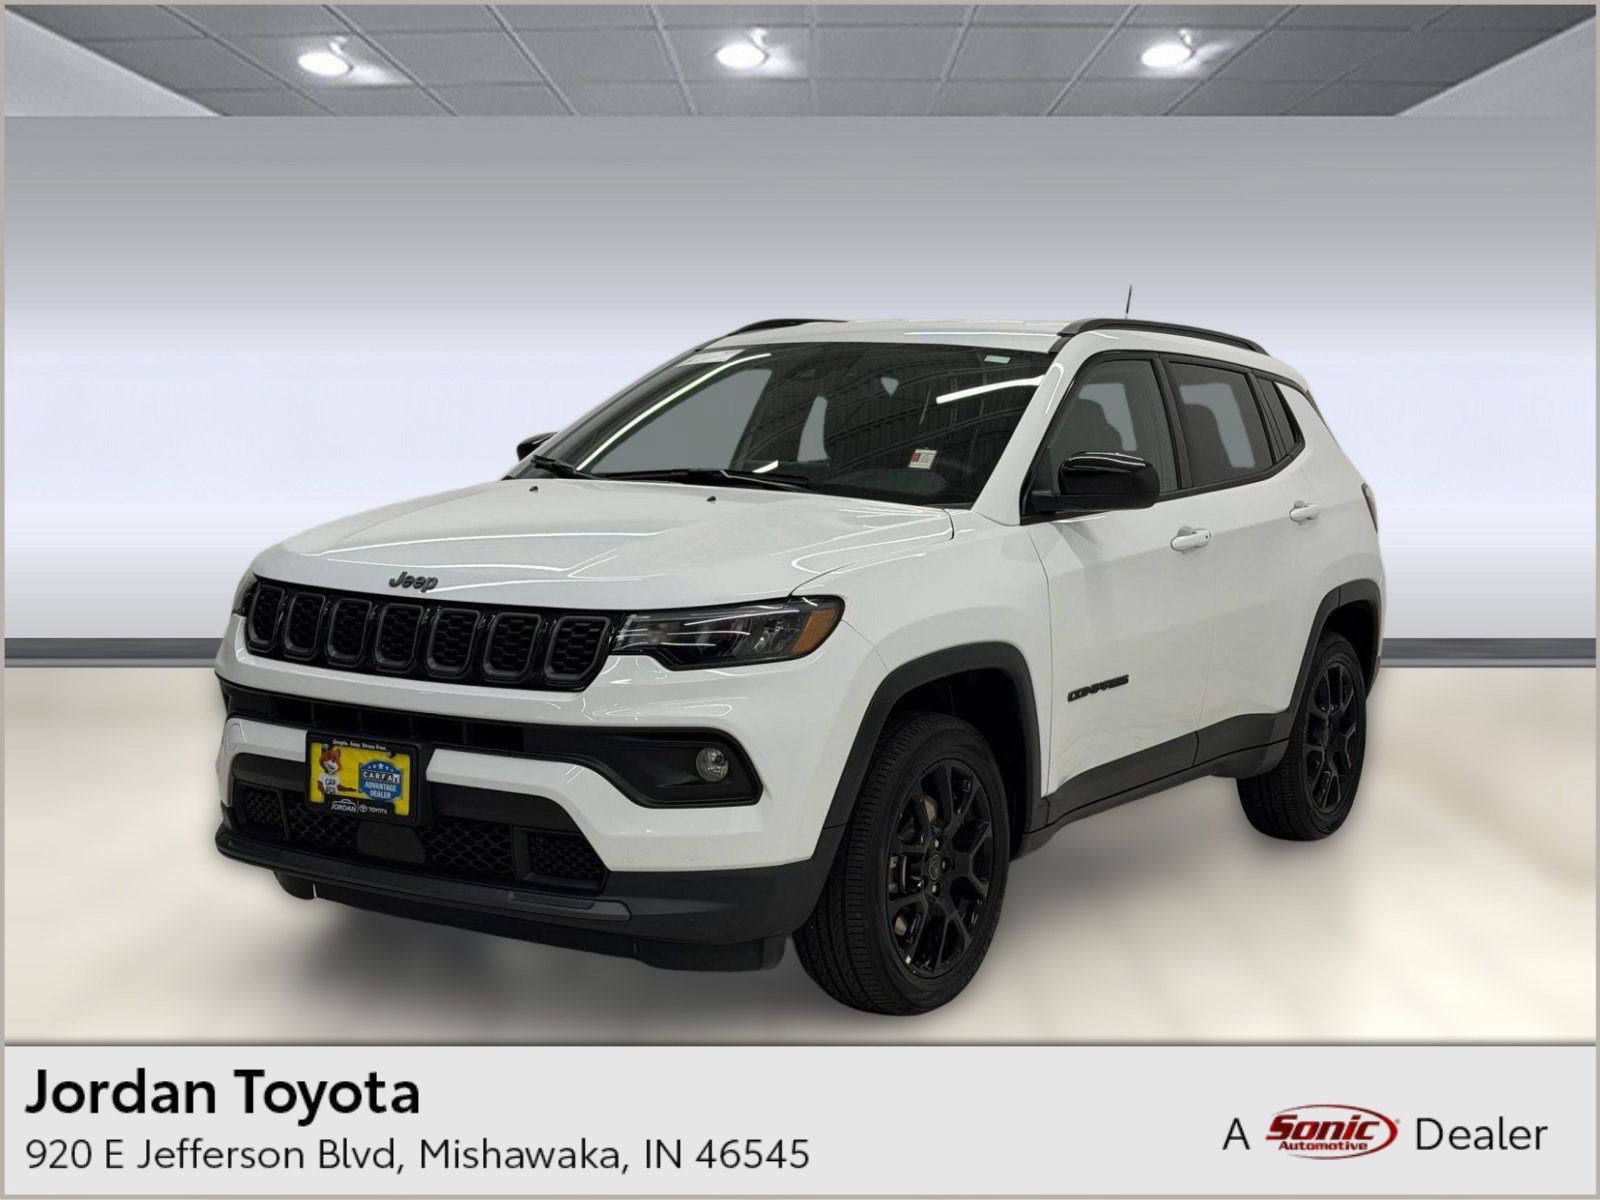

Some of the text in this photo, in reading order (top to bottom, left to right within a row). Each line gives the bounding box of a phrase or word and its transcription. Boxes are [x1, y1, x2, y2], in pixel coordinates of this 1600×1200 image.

[389, 571, 439, 593] Jeep
[365, 781, 396, 792] ADVANTAGE
[370, 789, 391, 799] DEALER
[331, 803, 388, 815] JORDAN TOYOTA
